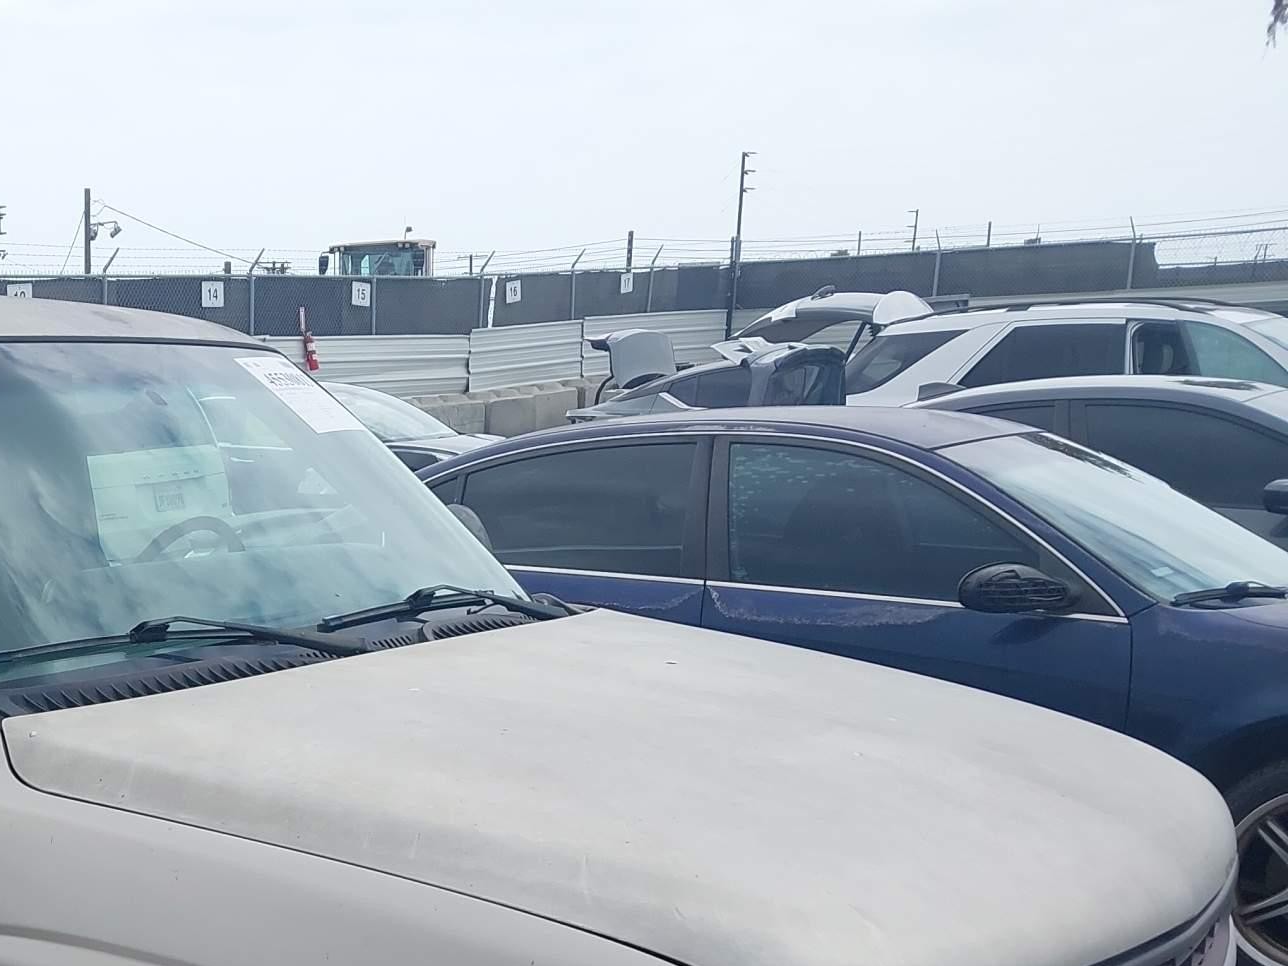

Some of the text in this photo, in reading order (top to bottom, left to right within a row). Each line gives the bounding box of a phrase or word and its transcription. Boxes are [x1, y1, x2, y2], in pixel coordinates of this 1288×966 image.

[624, 278, 630, 288] 17
[208, 288, 218, 301] 14
[357, 288, 366, 300] 15
[510, 286, 517, 297] 16
